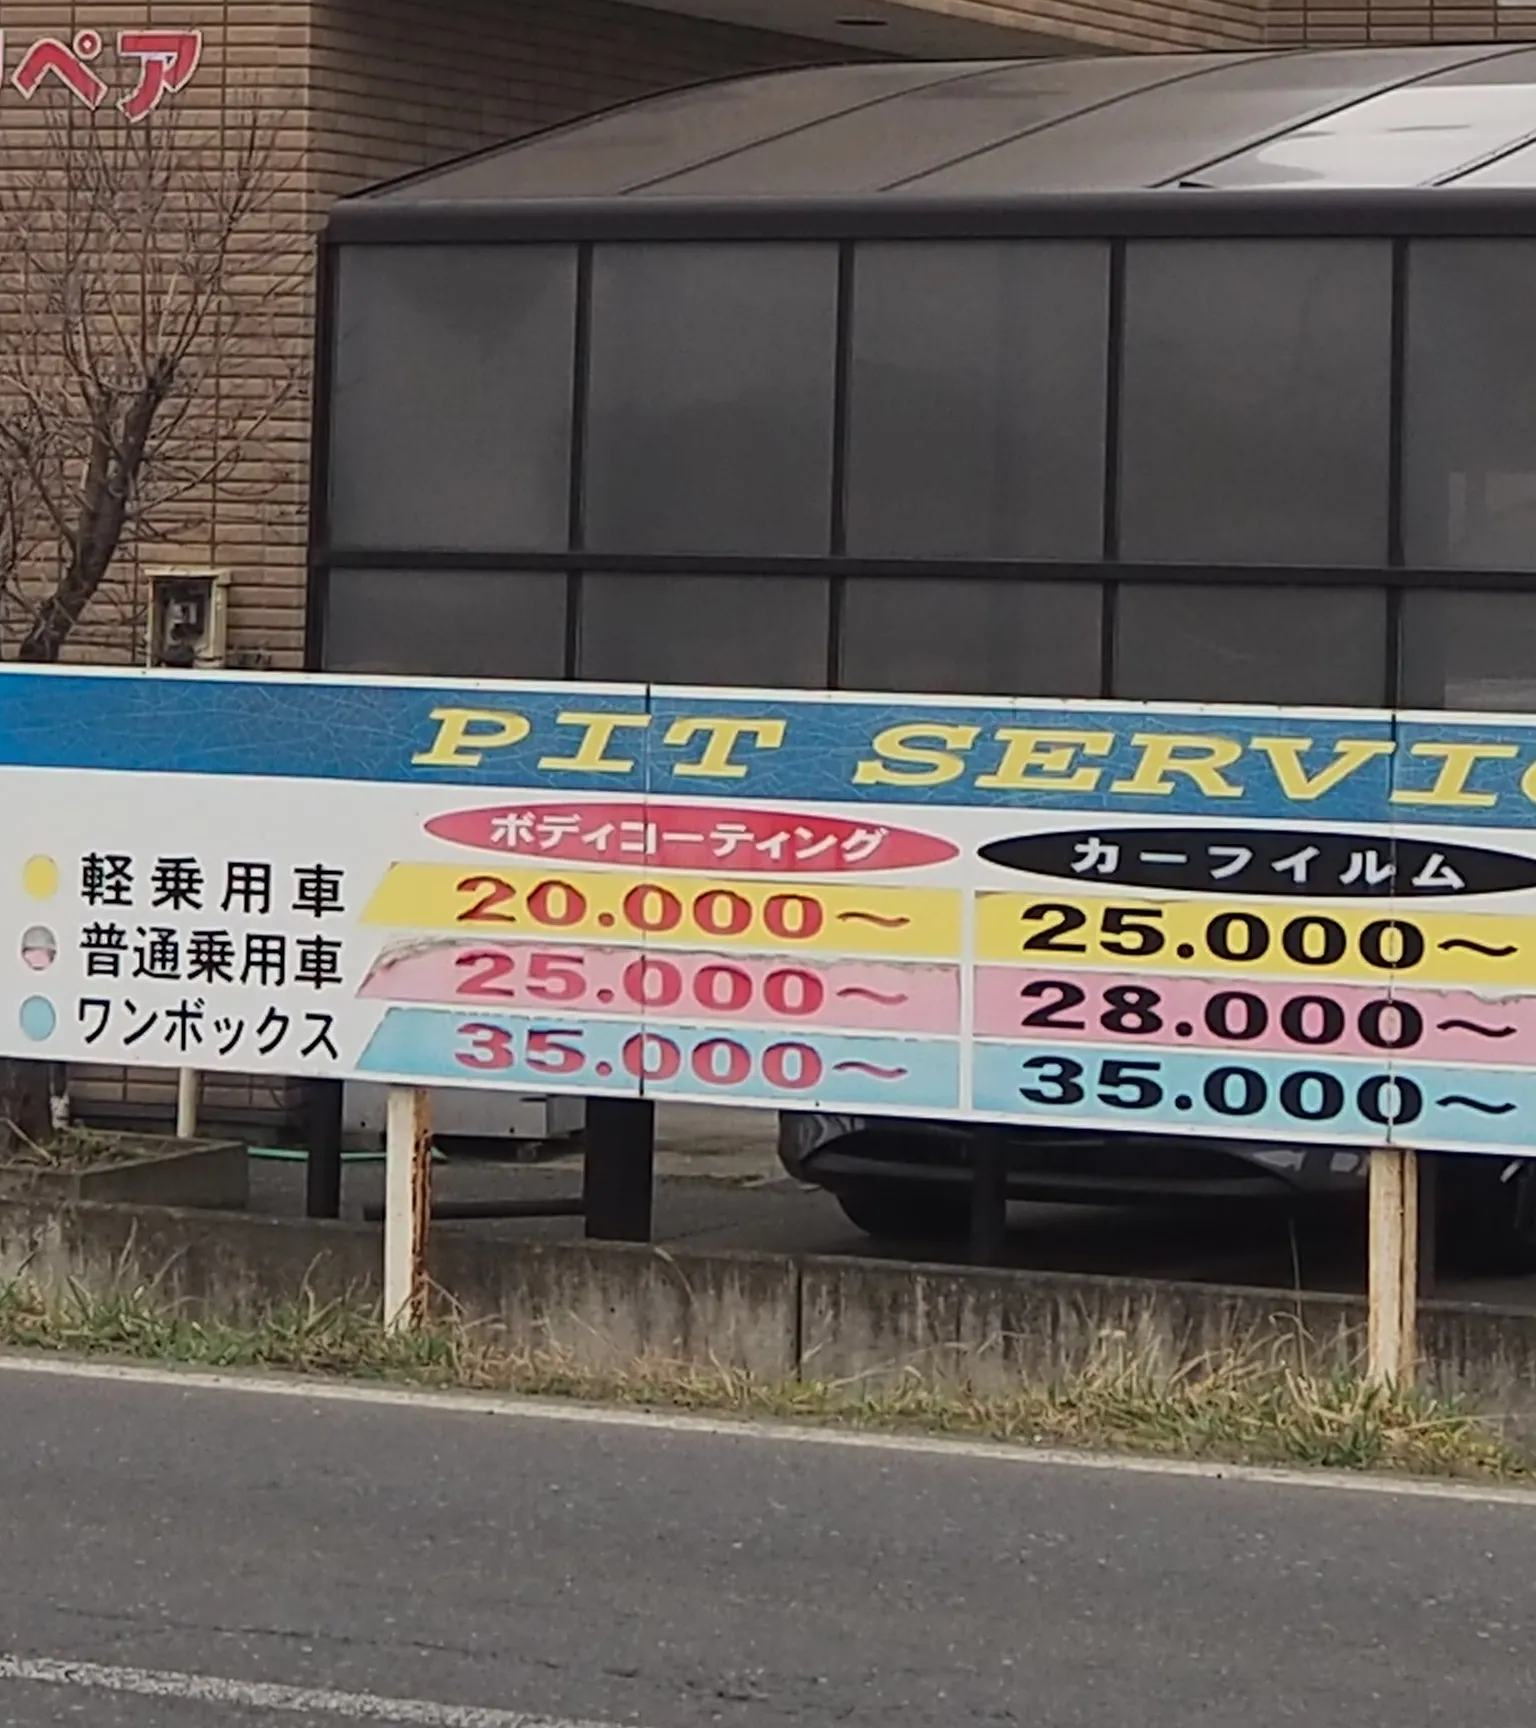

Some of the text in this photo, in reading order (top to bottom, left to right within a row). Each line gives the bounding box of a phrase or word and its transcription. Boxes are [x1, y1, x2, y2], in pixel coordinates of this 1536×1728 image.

[410, 707, 786, 778] PIT
[491, 811, 890, 863] ボディコーティング
[80, 851, 345, 918] 軽乗用車
[79, 921, 343, 990] 普通乗用車
[78, 997, 338, 1060] ワンボックス
